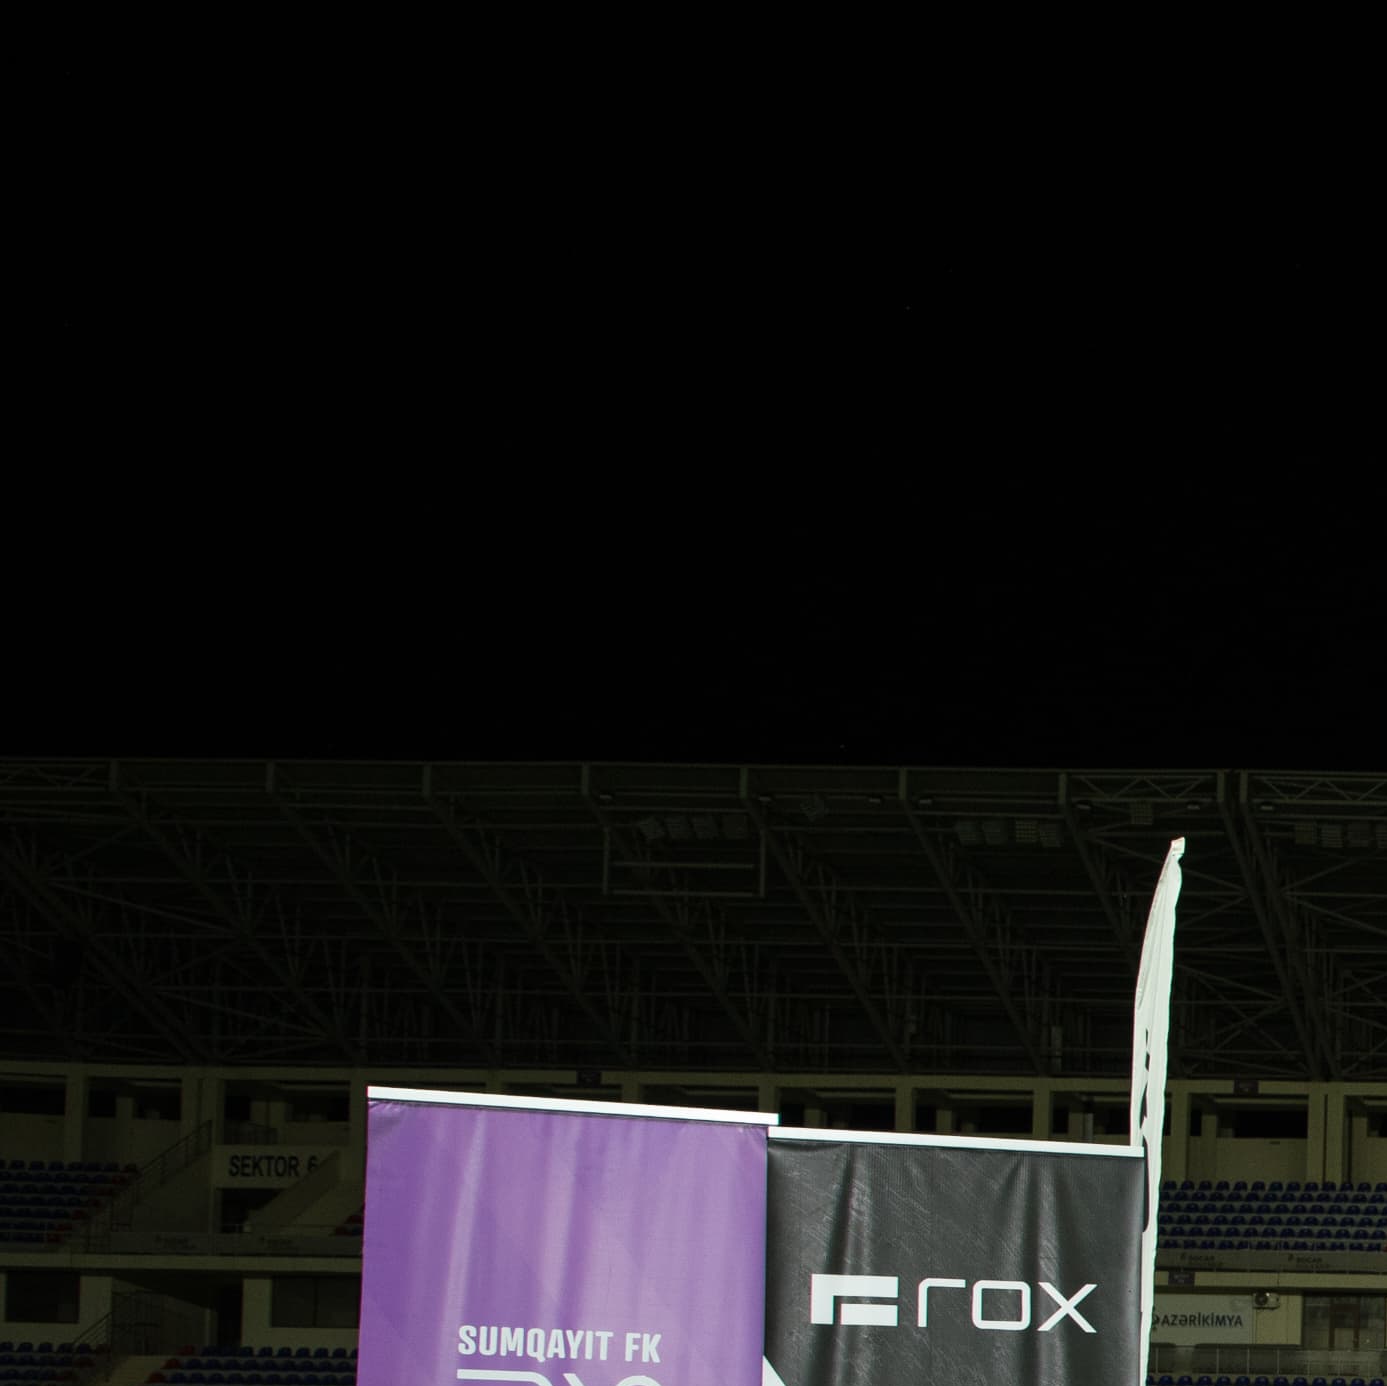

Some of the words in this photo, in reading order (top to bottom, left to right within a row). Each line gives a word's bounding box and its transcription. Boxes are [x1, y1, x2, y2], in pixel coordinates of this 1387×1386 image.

[229, 1155, 299, 1177] SEKTOR
[457, 1324, 614, 1363] SUMQAYIT
[624, 1332, 662, 1363] FK
